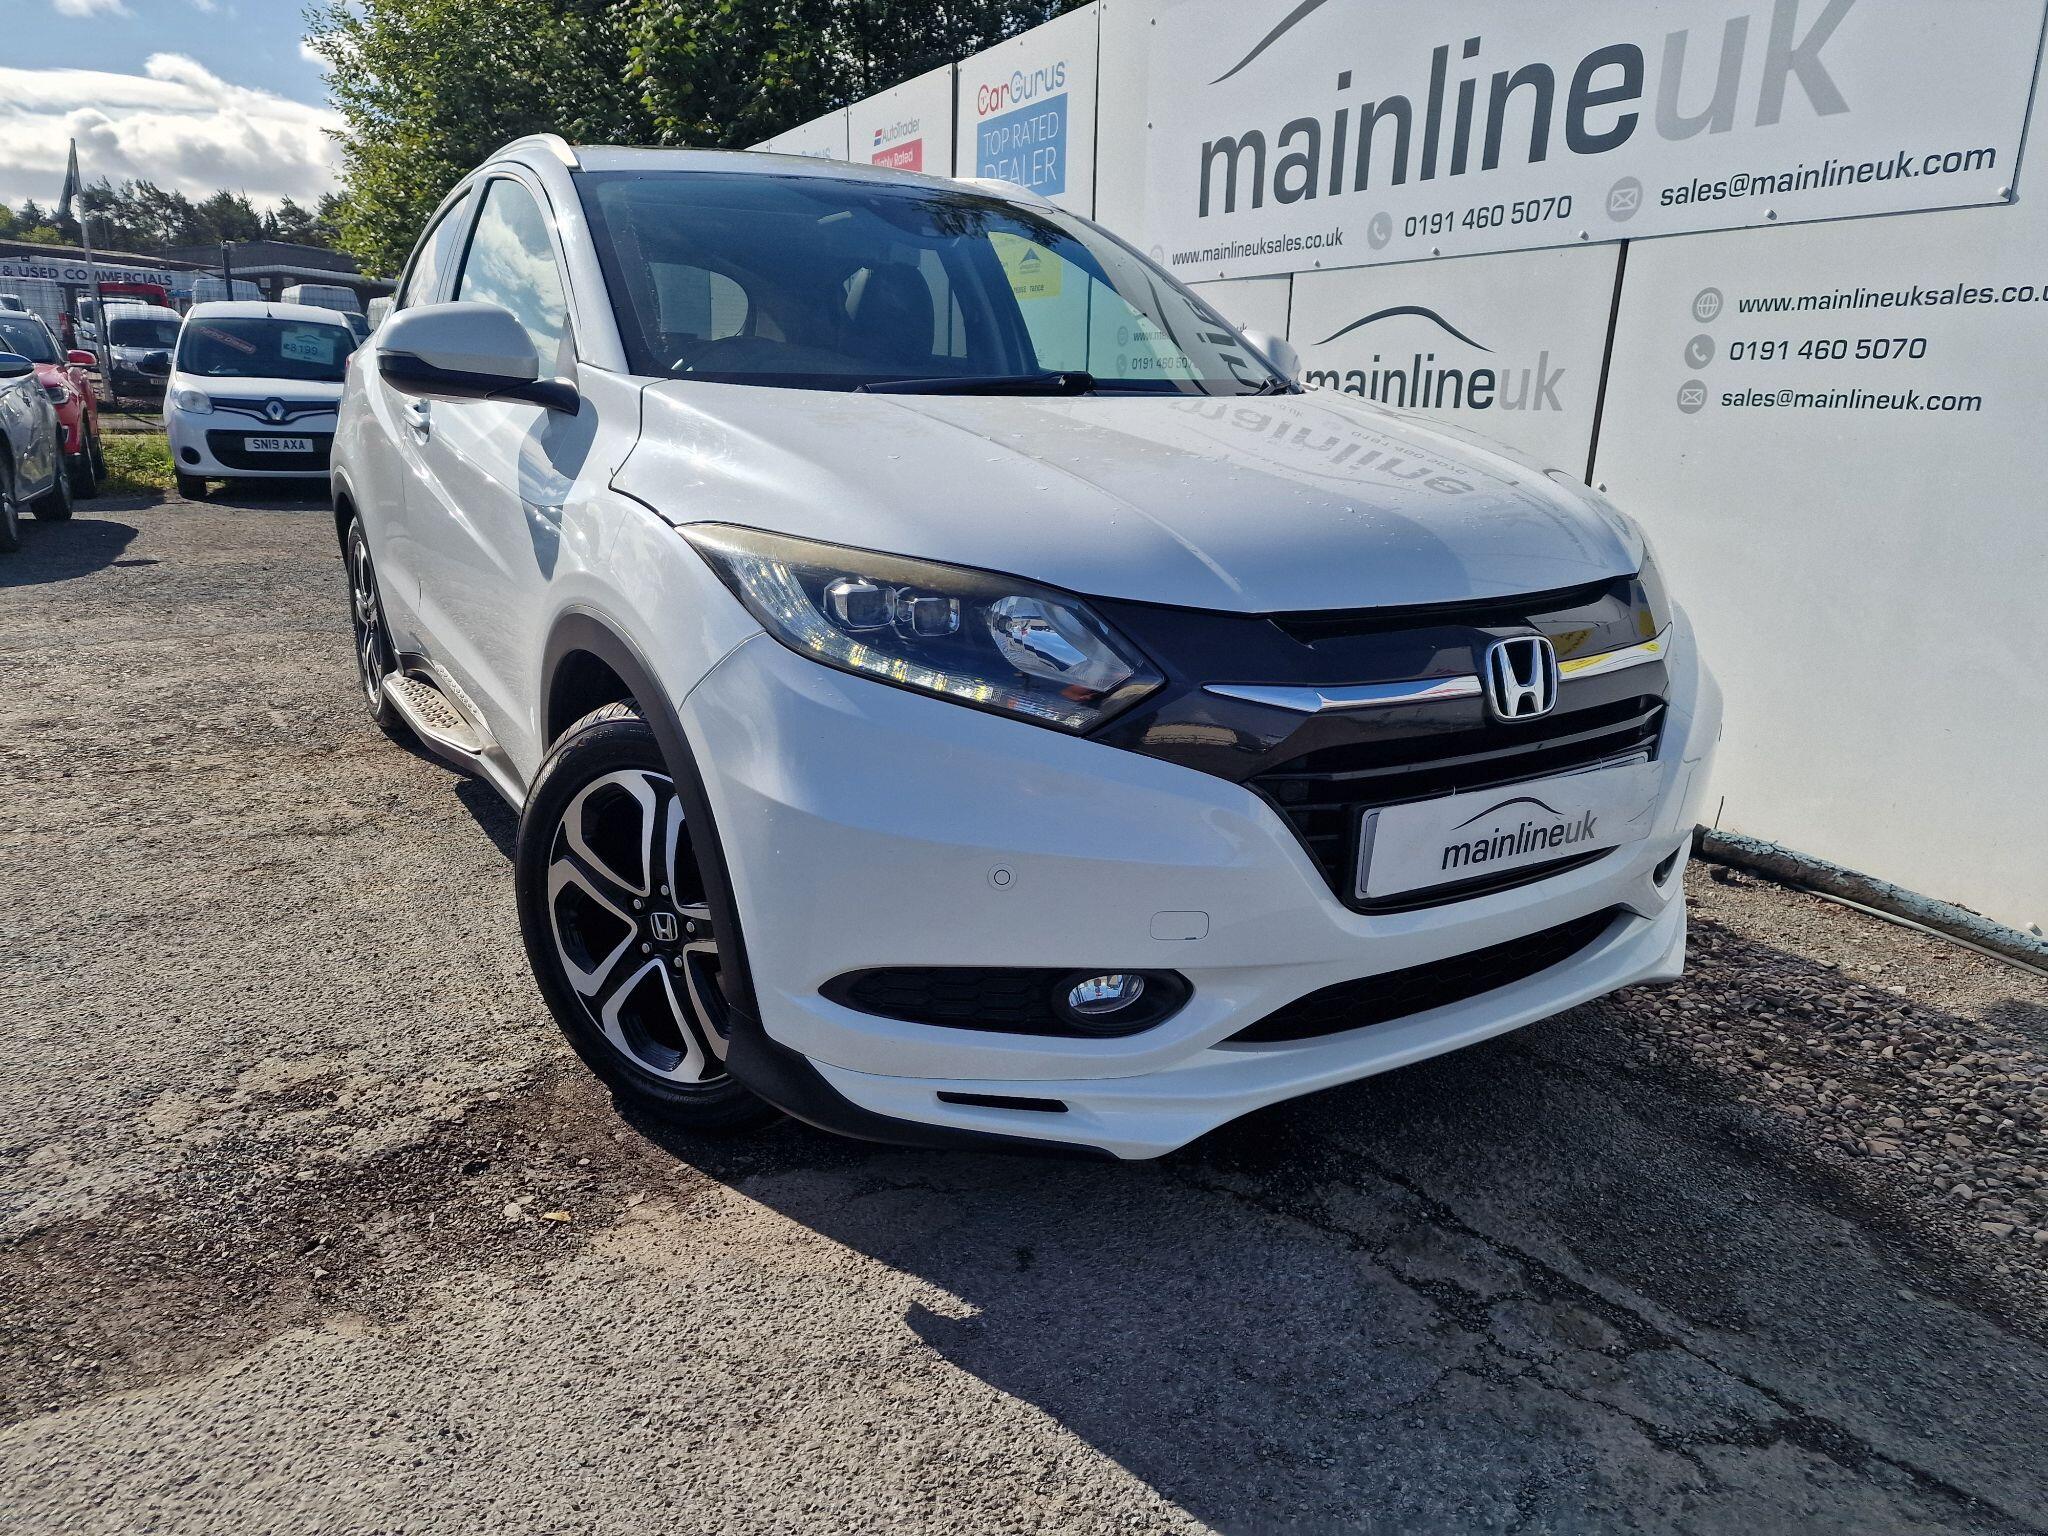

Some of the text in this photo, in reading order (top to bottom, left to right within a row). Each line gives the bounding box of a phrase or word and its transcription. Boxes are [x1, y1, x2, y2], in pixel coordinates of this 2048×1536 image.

[978, 61, 1065, 115] CarGurus
[1198, 0, 1857, 218] mainlineuk
[984, 111, 1059, 157] TOP RATED
[1660, 147, 1997, 207] sales@mainlineuk.com
[1404, 195, 1573, 238] 0191 460 5070
[1172, 227, 1344, 266] www.mainlineuksales.co.uk
[2, 265, 173, 286] & USED COMERCIALS
[1730, 337, 1927, 361] 0191 460 5070
[1721, 388, 1983, 412] sales@mainlineuk.com
[282, 439, 306, 450] AXA
[1441, 809, 1598, 870] mainlineuk
